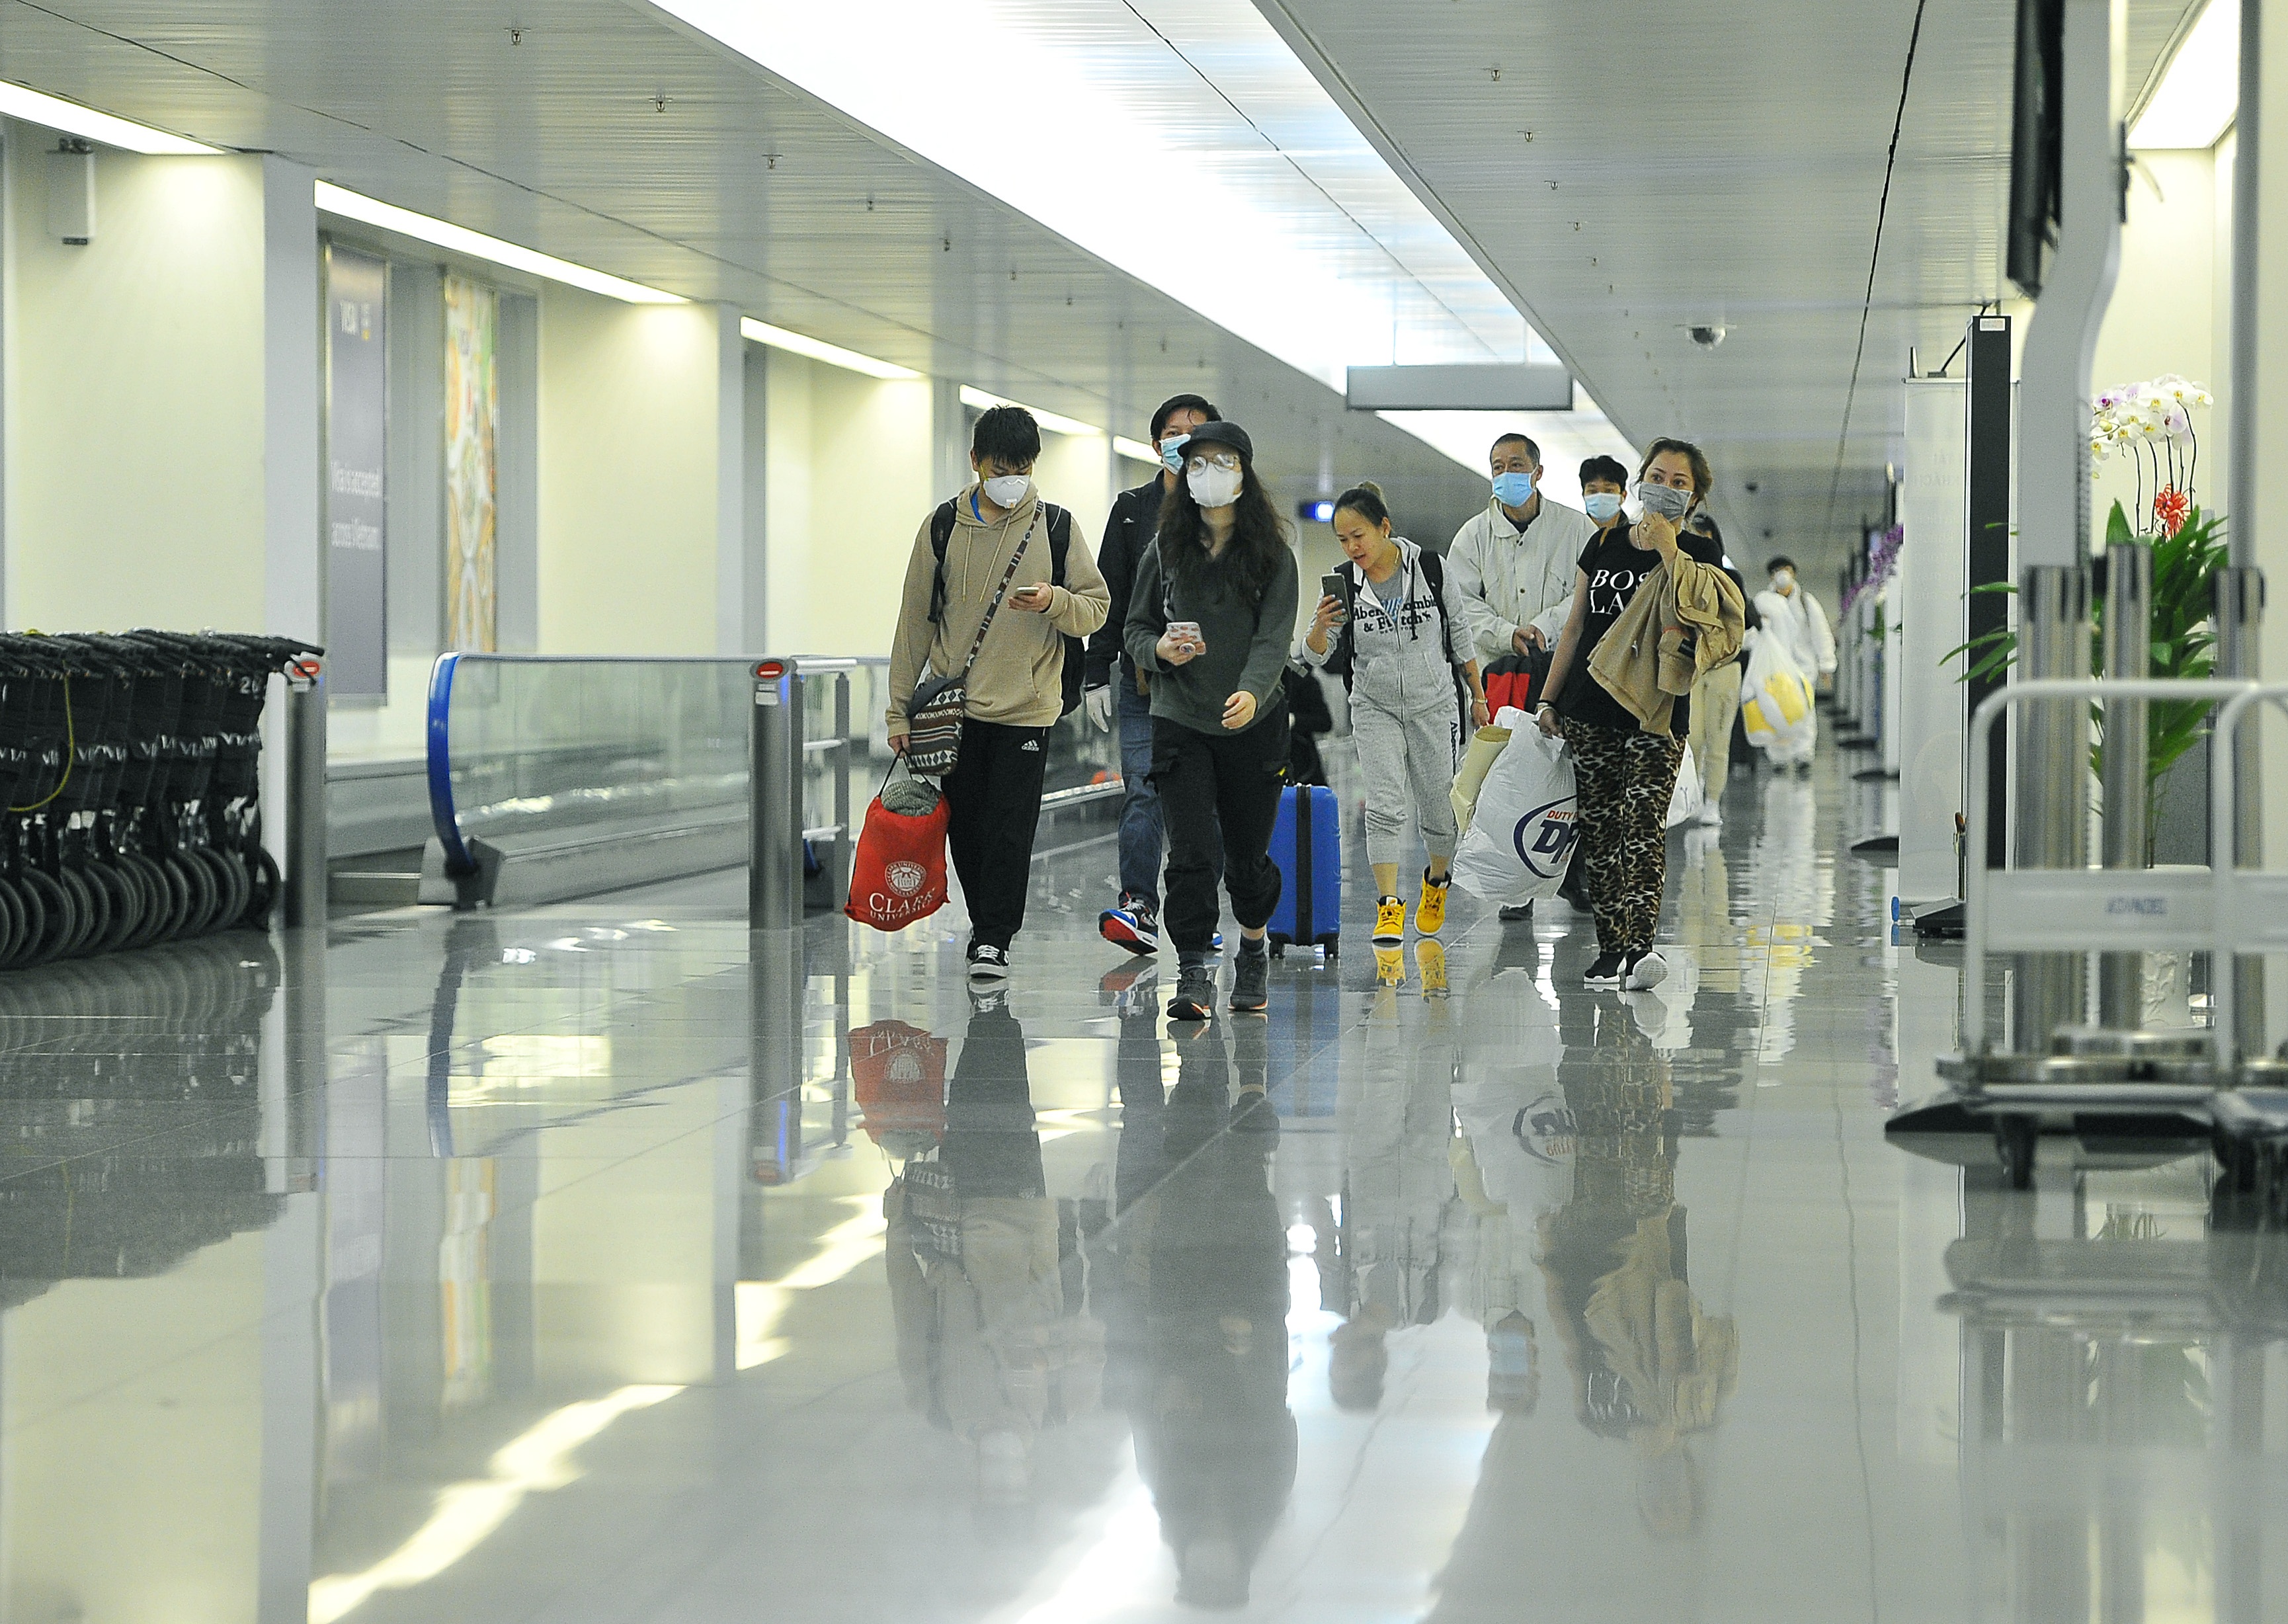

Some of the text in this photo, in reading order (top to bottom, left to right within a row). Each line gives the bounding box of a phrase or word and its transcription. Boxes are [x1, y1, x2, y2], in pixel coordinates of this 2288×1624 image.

[1590, 569, 1650, 590] BOS
[1590, 589, 1625, 615] LA
[1364, 623, 1373, 632] &
[1547, 810, 1573, 821] DUTY
[869, 887, 935, 913] CLARK
